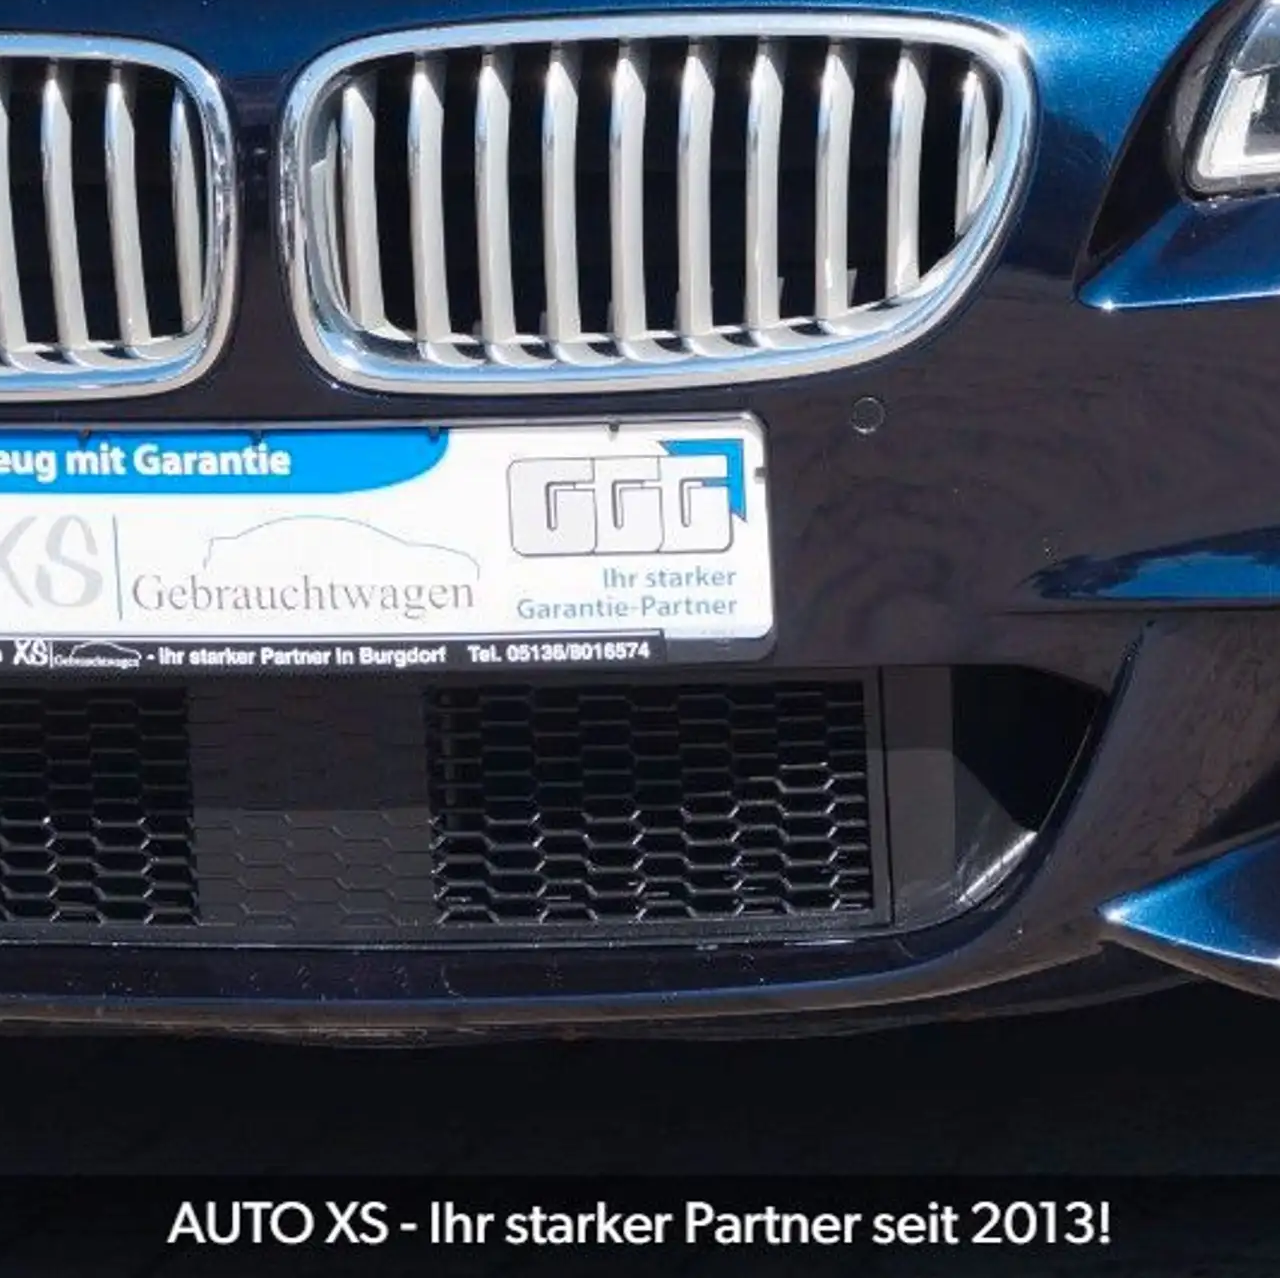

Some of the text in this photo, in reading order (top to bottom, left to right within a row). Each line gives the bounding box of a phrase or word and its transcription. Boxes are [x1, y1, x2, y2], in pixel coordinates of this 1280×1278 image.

[67, 443, 126, 476] mit
[133, 442, 292, 476] Garantie
[602, 565, 737, 589] Ihr starker
[131, 573, 475, 620] Gebrauchtwagen
[516, 595, 738, 620] Garantie-Partner
[12, 638, 48, 667] XS
[159, 647, 185, 665] Ihr
[189, 646, 255, 665] starker
[260, 646, 332, 665] Partner
[359, 645, 447, 669] Burgdorf
[467, 643, 502, 663] Tel.
